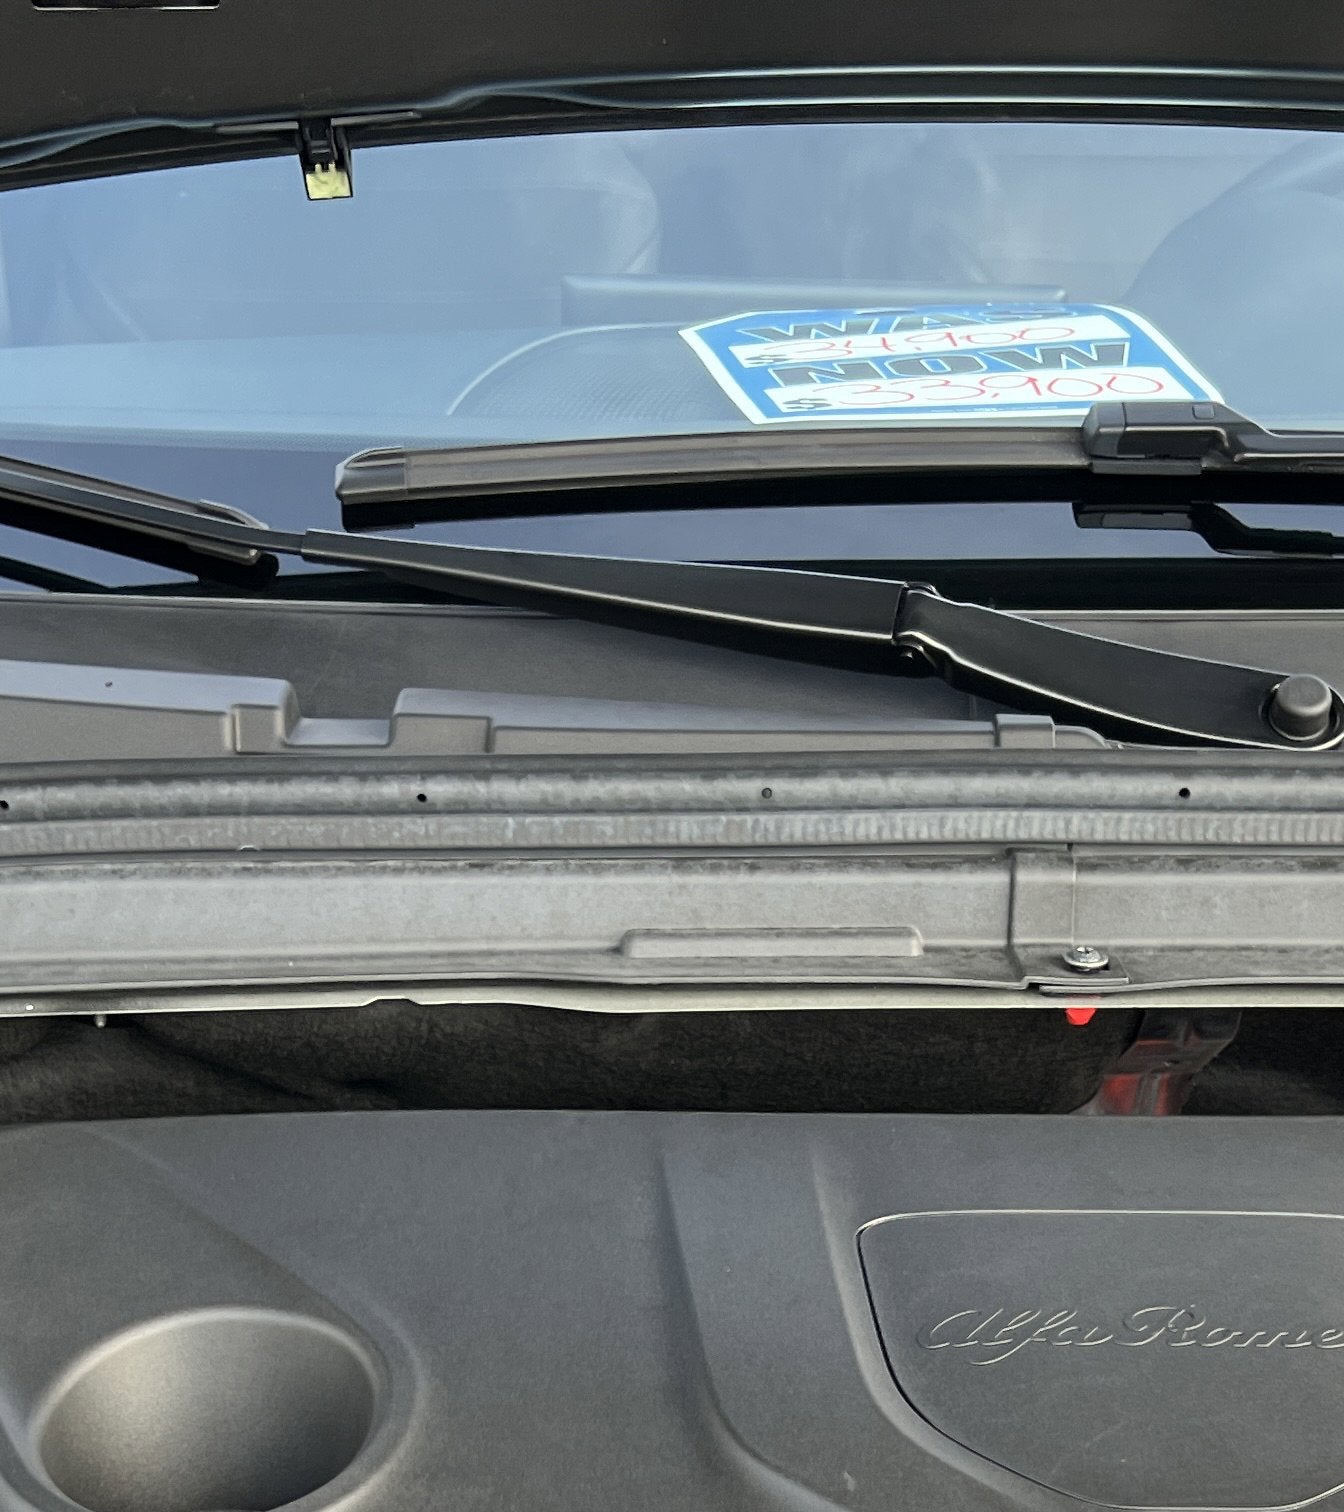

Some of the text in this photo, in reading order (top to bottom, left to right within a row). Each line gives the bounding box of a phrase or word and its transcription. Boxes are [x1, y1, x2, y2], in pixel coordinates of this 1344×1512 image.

[740, 305, 1081, 342] WAS
[768, 342, 1130, 388] NOW
[918, 1309, 1114, 1366] Alfa
